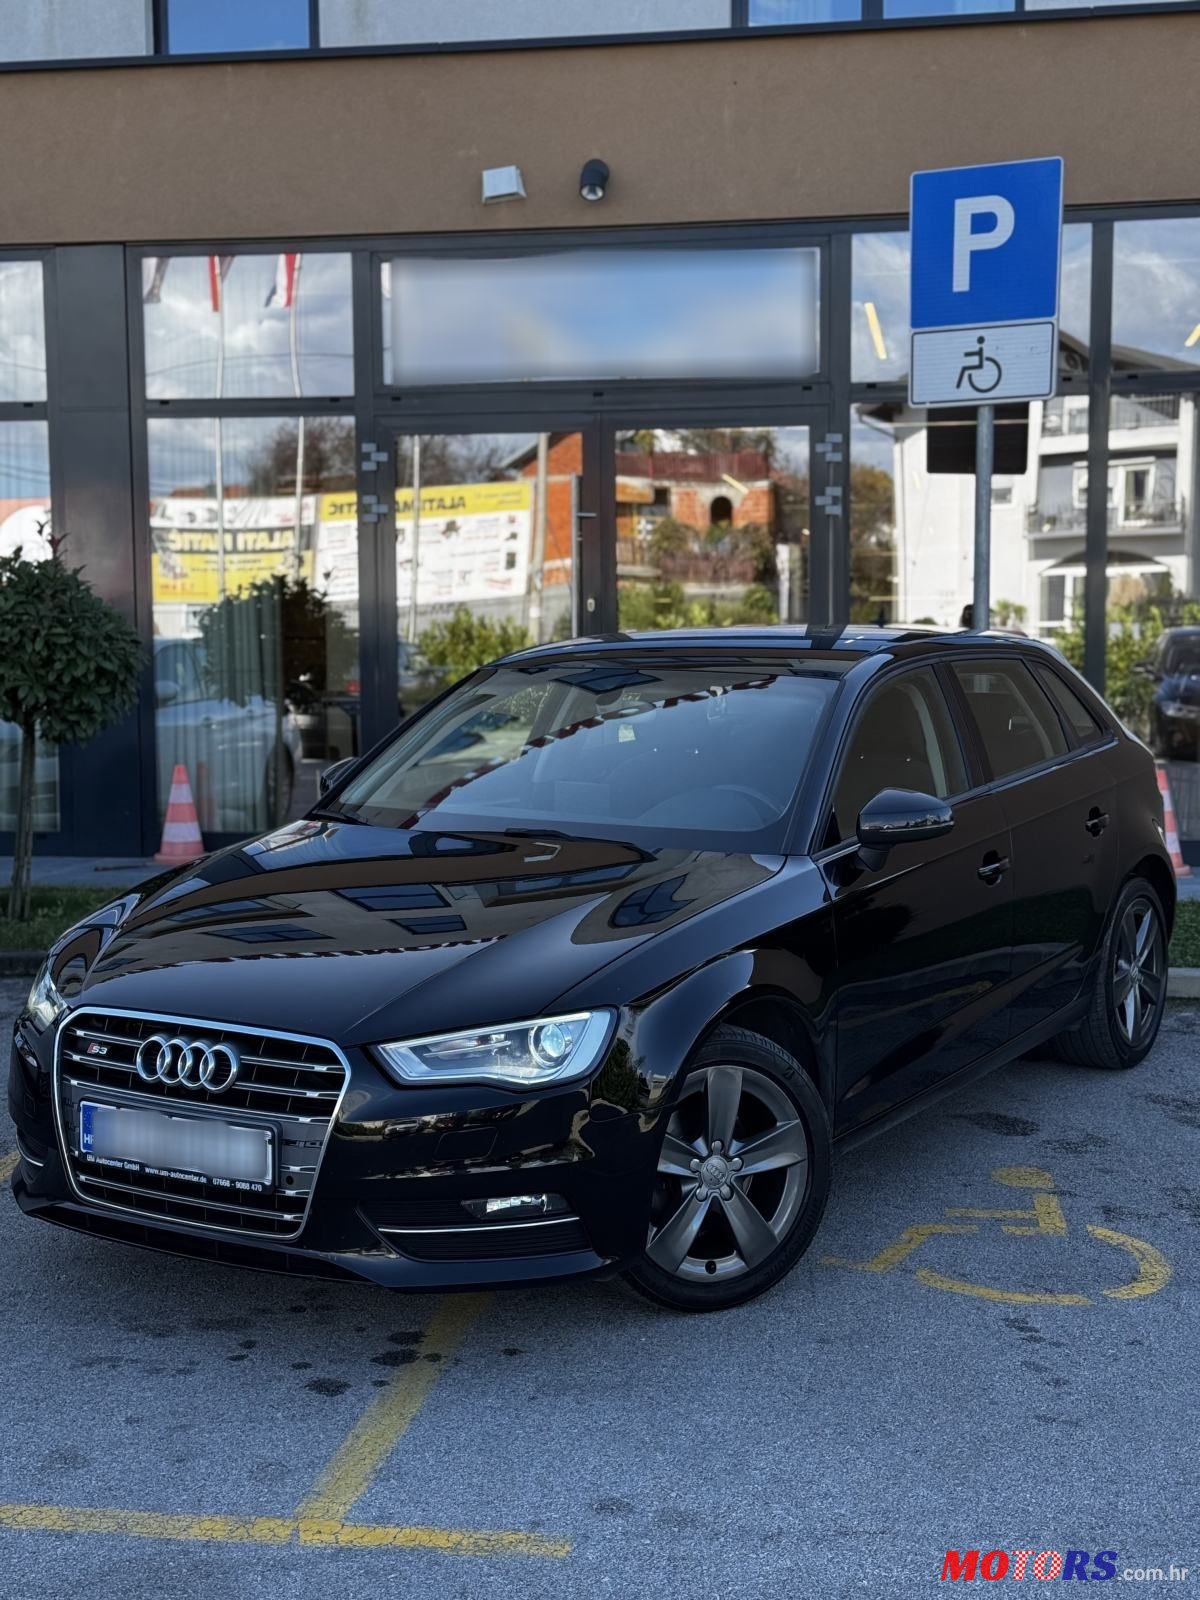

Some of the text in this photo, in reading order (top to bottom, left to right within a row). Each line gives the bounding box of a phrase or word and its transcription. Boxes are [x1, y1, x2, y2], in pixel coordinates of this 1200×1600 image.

[952, 194, 1015, 292] P
[90, 1044, 108, 1055] S3
[96, 1156, 123, 1168] Autocenter
[123, 1161, 140, 1171] GmbH
[144, 1167, 207, 1184] www.um-autocenter.de
[250, 1183, 263, 1192] 470
